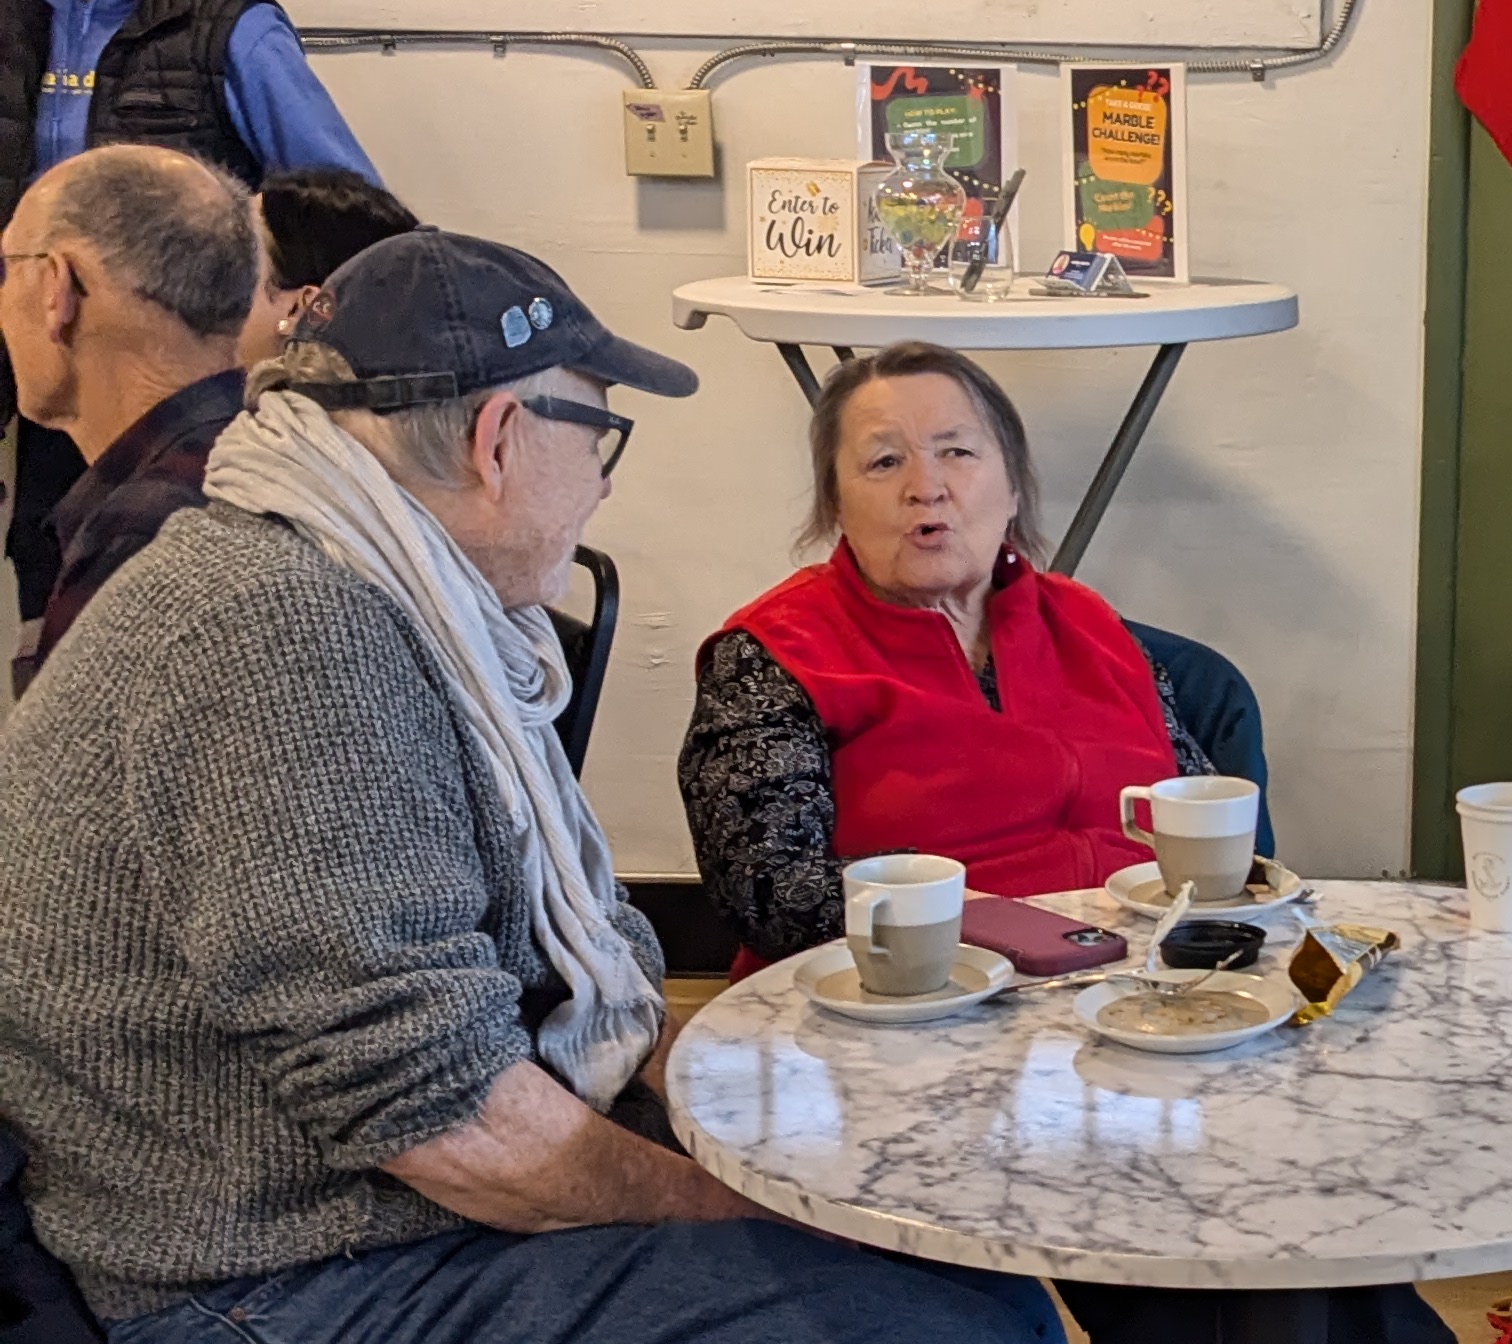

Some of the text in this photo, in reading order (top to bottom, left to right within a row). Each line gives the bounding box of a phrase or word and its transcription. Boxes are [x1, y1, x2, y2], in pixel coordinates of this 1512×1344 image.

[1102, 112, 1155, 129] MARBLE
[1092, 127, 1160, 145] CHALLENGE!
[768, 189, 840, 215] Enter to
[765, 216, 842, 259] Win
